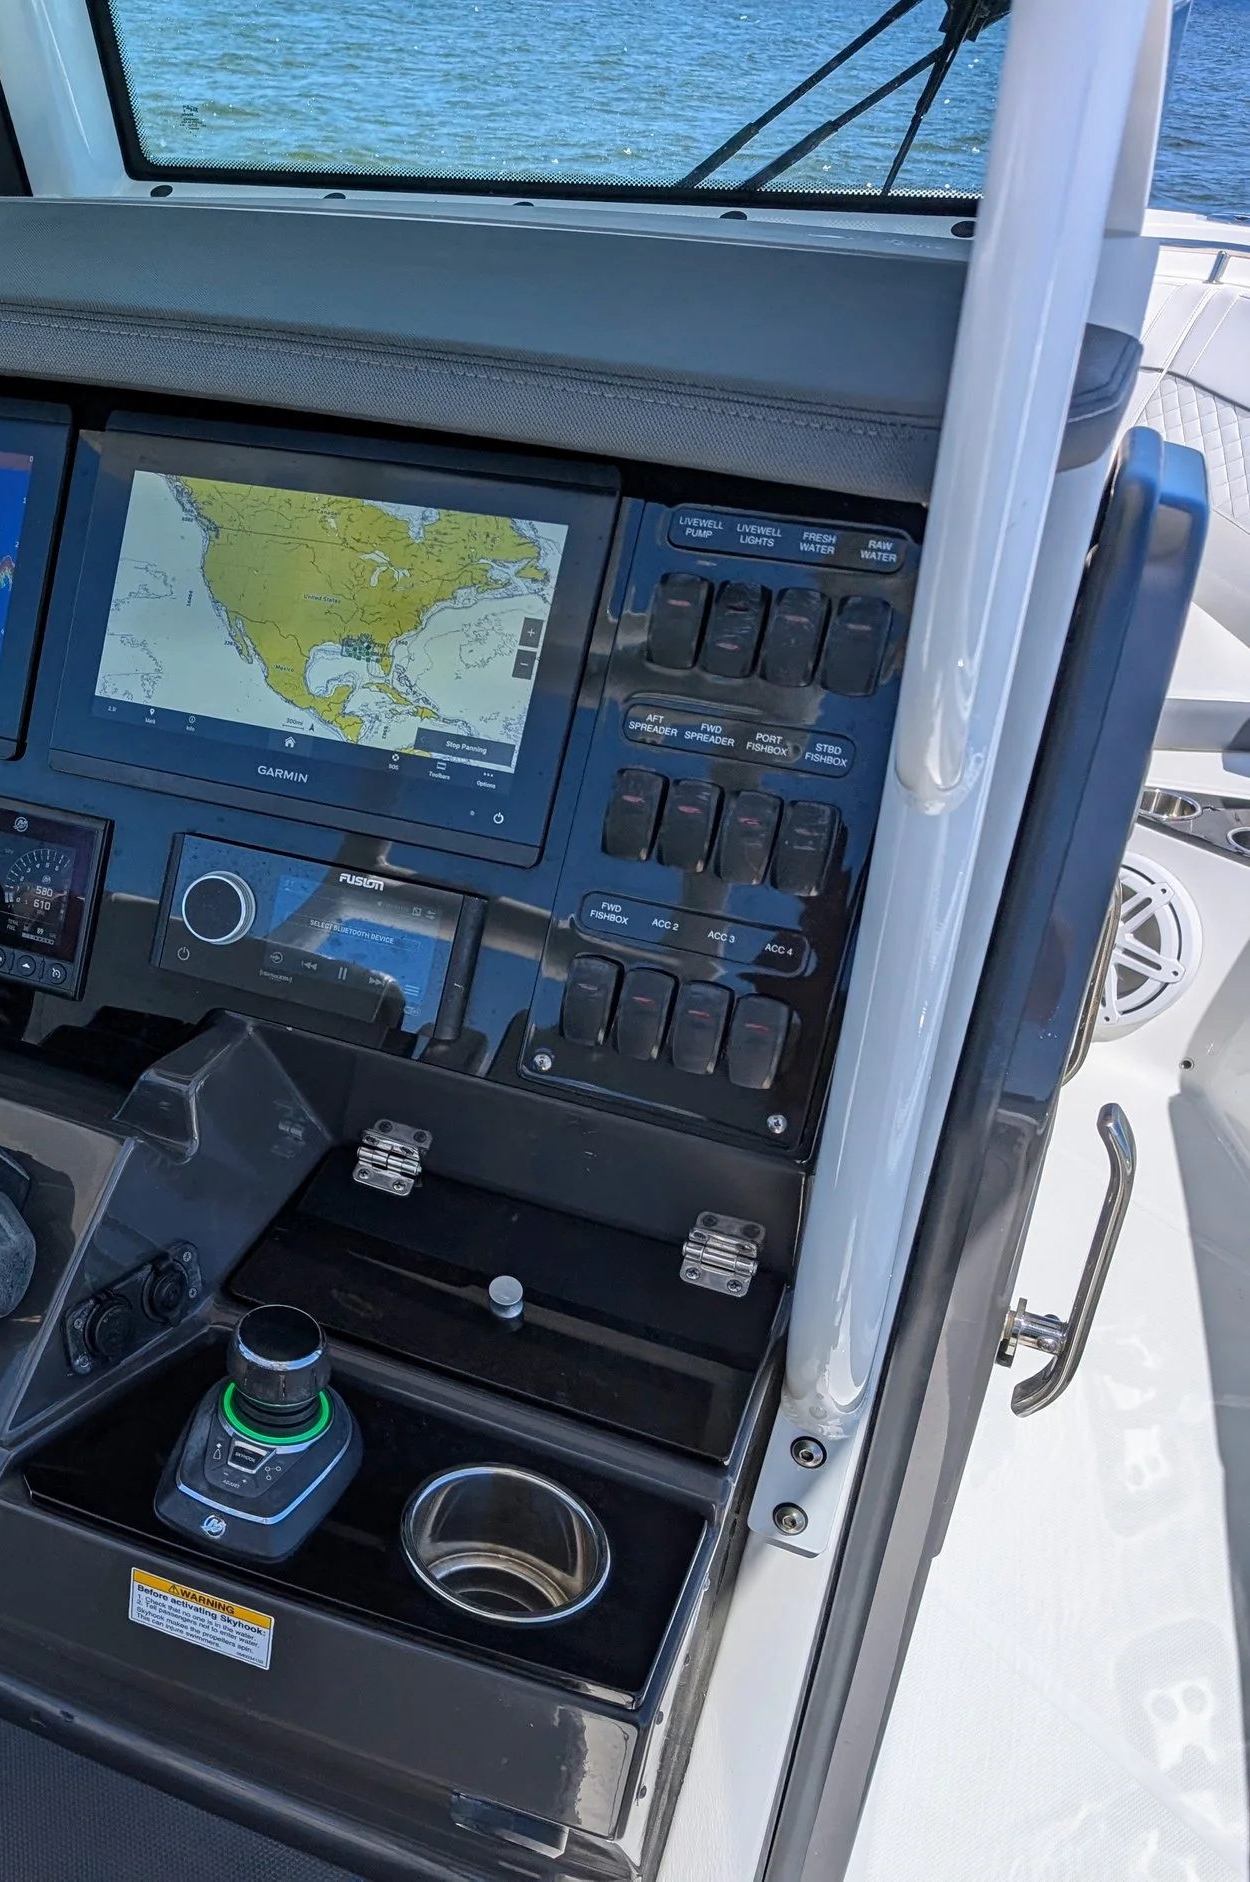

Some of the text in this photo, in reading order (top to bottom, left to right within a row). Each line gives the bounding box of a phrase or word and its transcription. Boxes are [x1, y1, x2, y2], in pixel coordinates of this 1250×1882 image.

[679, 516, 723, 529] LIVEWELL
[685, 528, 712, 539] PUMP
[737, 524, 782, 537] LIVEWELL
[739, 535, 774, 547] LIGHTS
[803, 532, 837, 544] FRESH
[800, 543, 835, 555] WATER
[868, 540, 893, 551] RAW
[860, 550, 897, 563] WATER
[646, 714, 664, 724] AFT
[628, 721, 677, 737] SPREADER
[701, 723, 722, 734] FWD
[684, 731, 735, 747] SPREADER
[756, 733, 782, 744] PORT
[446, 741, 487, 755] Stop Panning
[746, 742, 787, 757] FISHBOX
[815, 743, 842, 755] STBD
[805, 752, 847, 768] FISHBOX
[257, 765, 308, 783] GARMIN
[429, 771, 450, 780] Toolbars
[477, 780, 496, 789] Options
[339, 873, 385, 892] FUSION
[36, 886, 53, 897] 580
[33, 900, 50, 910] 610
[601, 902, 622, 912] FWD
[590, 910, 629, 925] FISHBOX
[652, 919, 671, 930] ACC
[310, 919, 395, 944] SELECT BLUETOOTH DEVICE
[708, 931, 735, 943] ACC 3
[765, 944, 793, 956] ACC 4
[222, 1480, 240, 1488] ADJUST
[180, 1588, 235, 1615] WARNING
[137, 1584, 266, 1638] Before activating Skyhook:
[145, 1596, 166, 1608] Check
[167, 1604, 180, 1614] that
[181, 1609, 190, 1617] no
[192, 1613, 205, 1622] one
[222, 1624, 233, 1633] the
[235, 1628, 256, 1641] water.
[145, 1601, 156, 1610] Tell
[158, 1606, 197, 1626] passengers
[198, 1621, 209, 1629] not
[219, 1628, 236, 1639] enter
[238, 1635, 259, 1647] water.
[136, 1612, 220, 1648] This can injure swimmers.
[136, 1606, 253, 1655] Skyhook makes the propellers spin.
